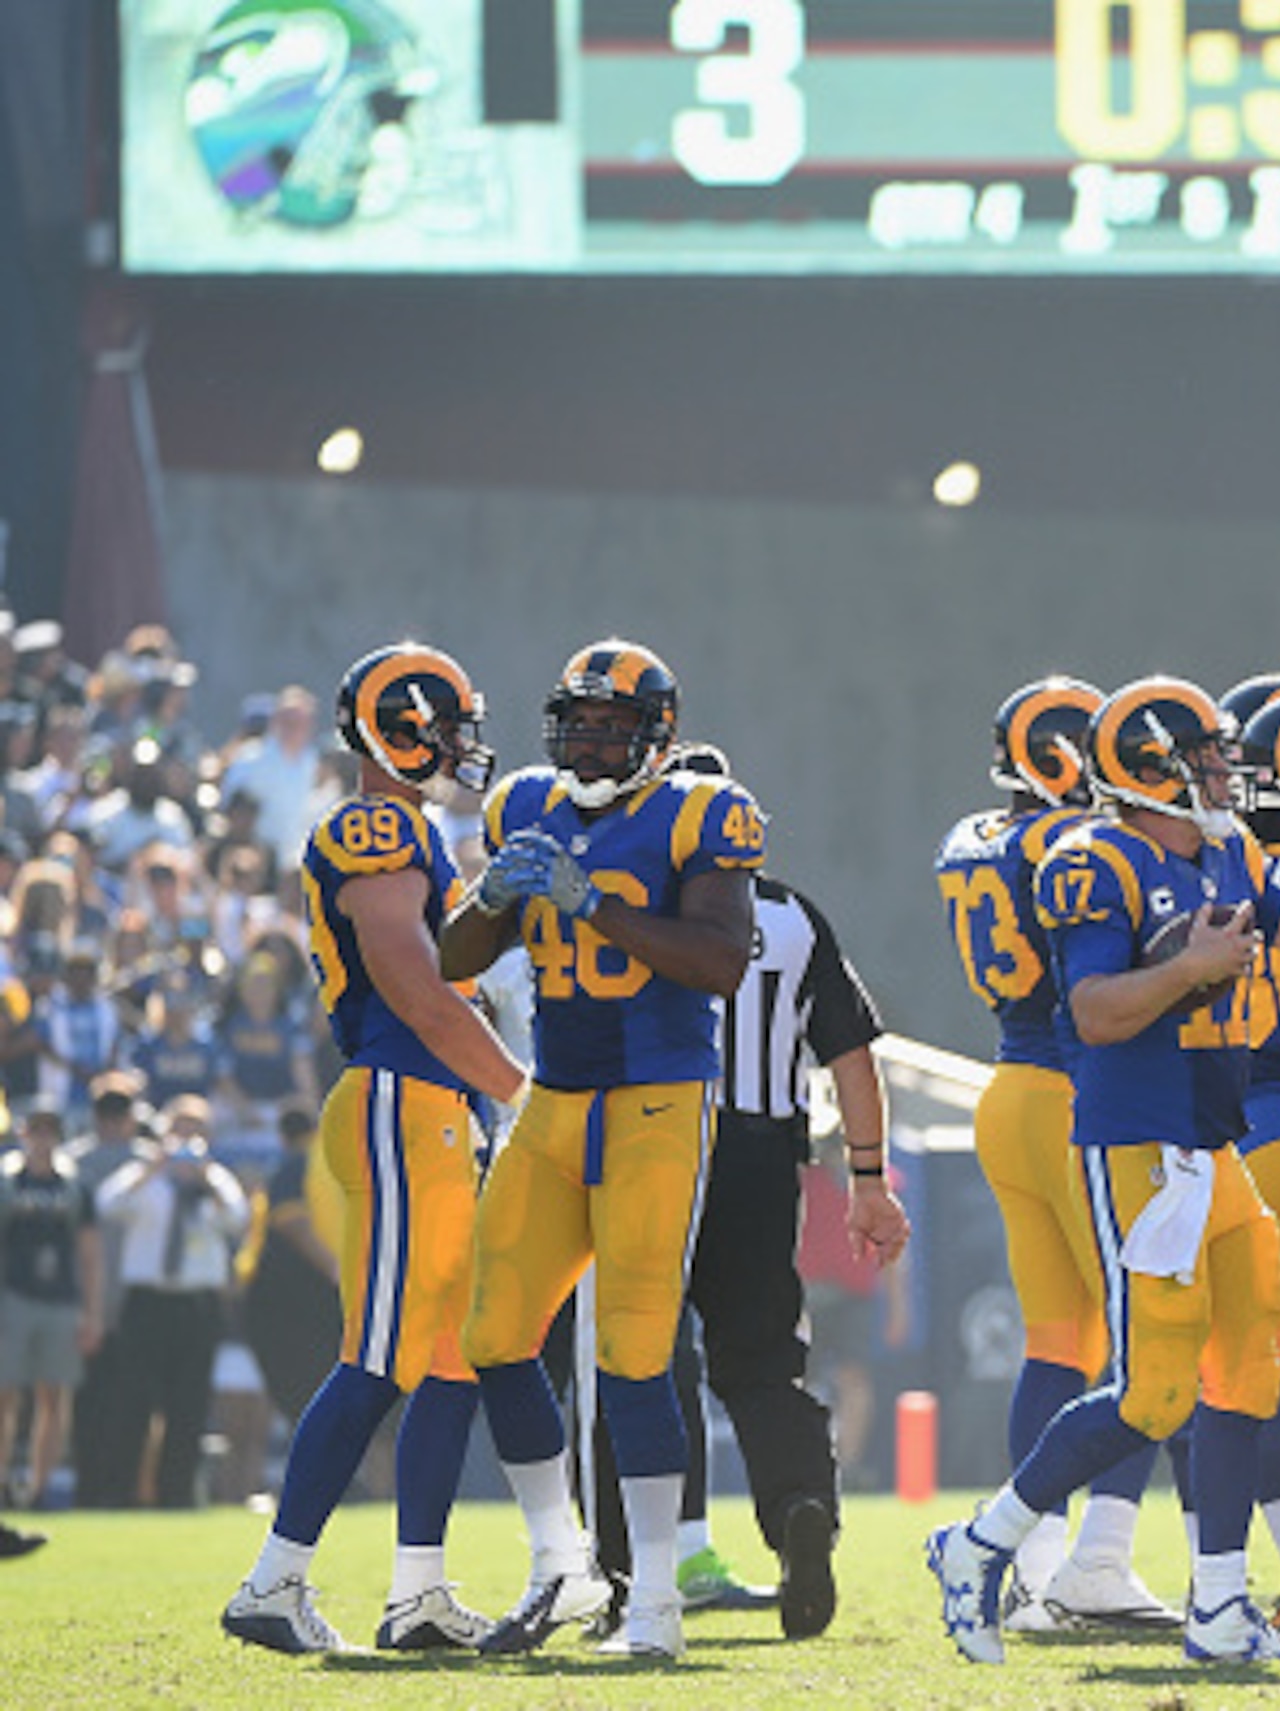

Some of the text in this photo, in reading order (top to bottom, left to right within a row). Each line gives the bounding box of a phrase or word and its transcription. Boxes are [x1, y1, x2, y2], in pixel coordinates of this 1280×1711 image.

[671, 0, 805, 186] 3
[343, 808, 400, 853] 89
[938, 866, 1045, 1007] 73
[1053, 869, 1097, 912] 17
